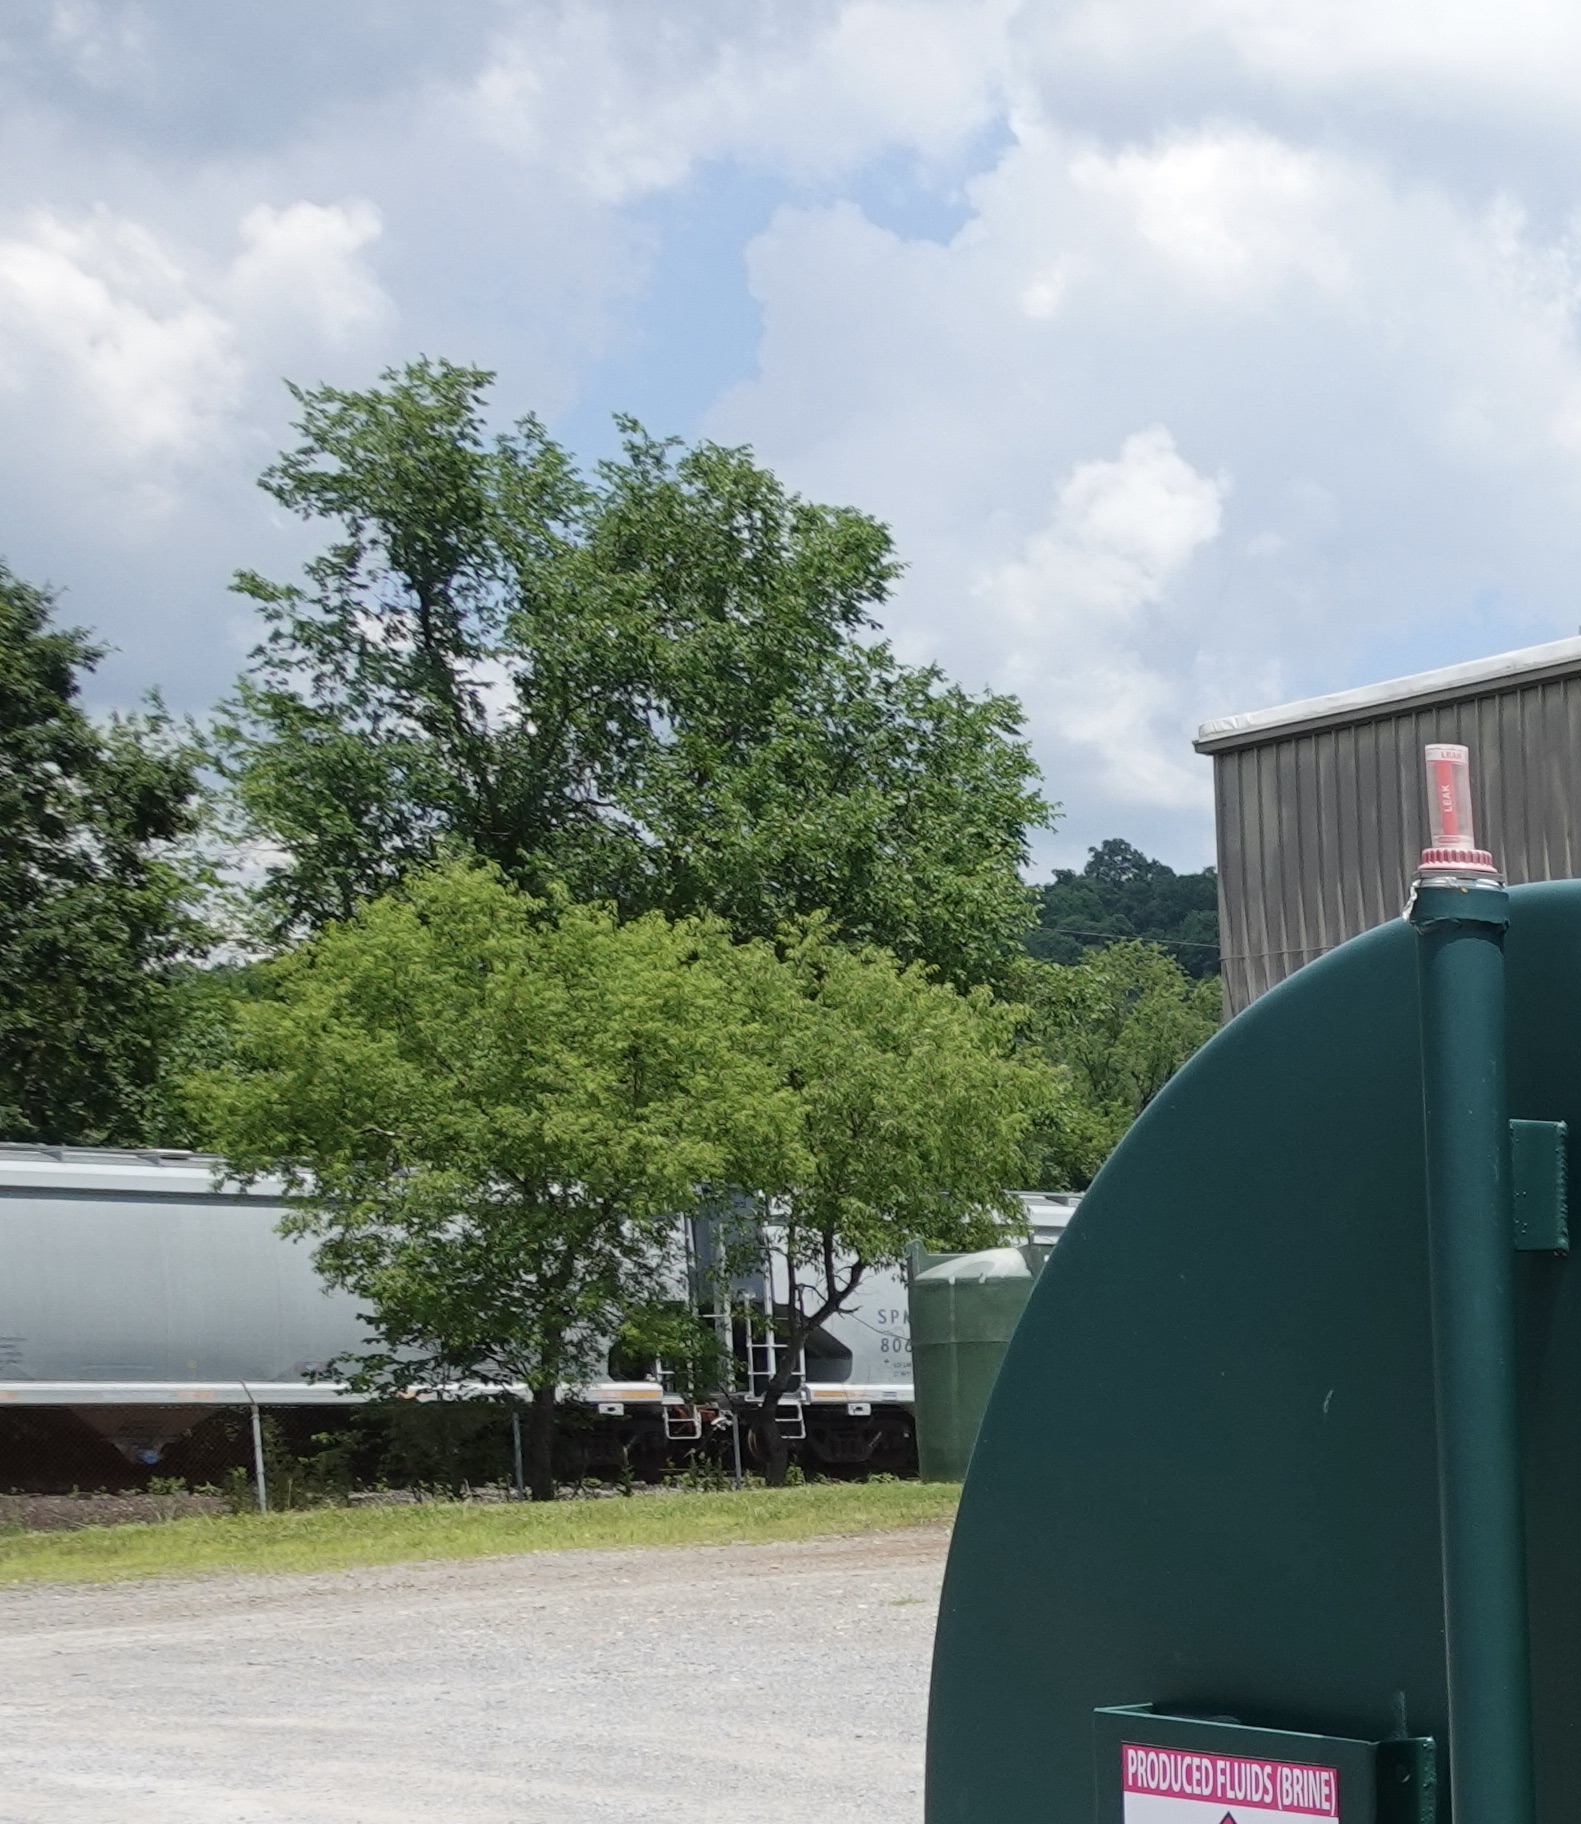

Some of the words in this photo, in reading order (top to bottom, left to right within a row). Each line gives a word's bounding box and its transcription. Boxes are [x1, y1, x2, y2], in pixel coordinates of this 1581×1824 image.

[1441, 785, 1453, 812] LEAK
[1127, 1748, 1214, 1797] PRODUCED
[1216, 1759, 1273, 1804] FLUIDS
[1276, 1766, 1336, 1817] (BRINE)
